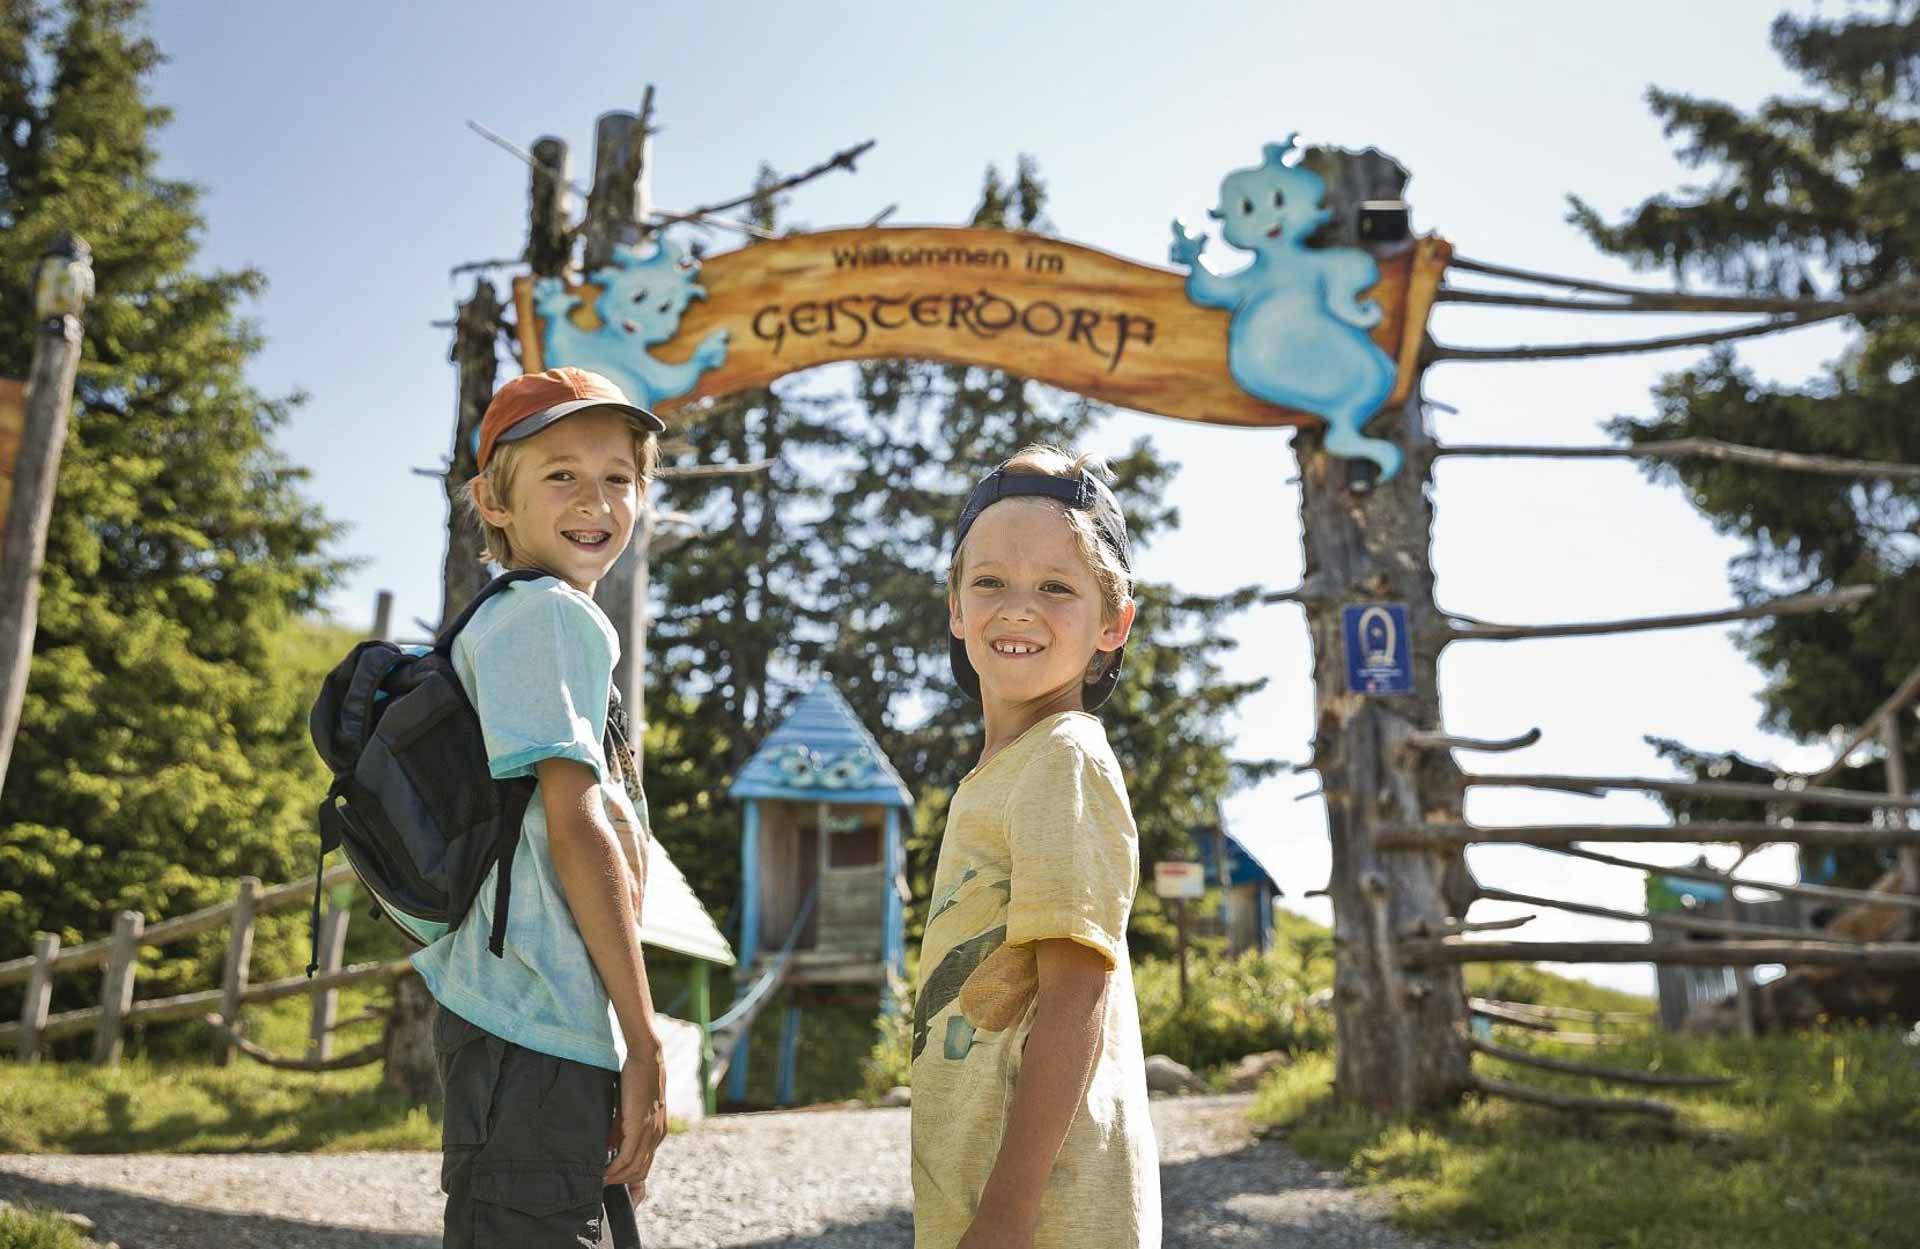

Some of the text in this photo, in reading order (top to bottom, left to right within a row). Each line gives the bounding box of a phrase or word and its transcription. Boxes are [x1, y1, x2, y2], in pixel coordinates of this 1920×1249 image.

[833, 245, 1064, 273] Willkommen im
[752, 289, 1156, 373] GEISTERDORF
